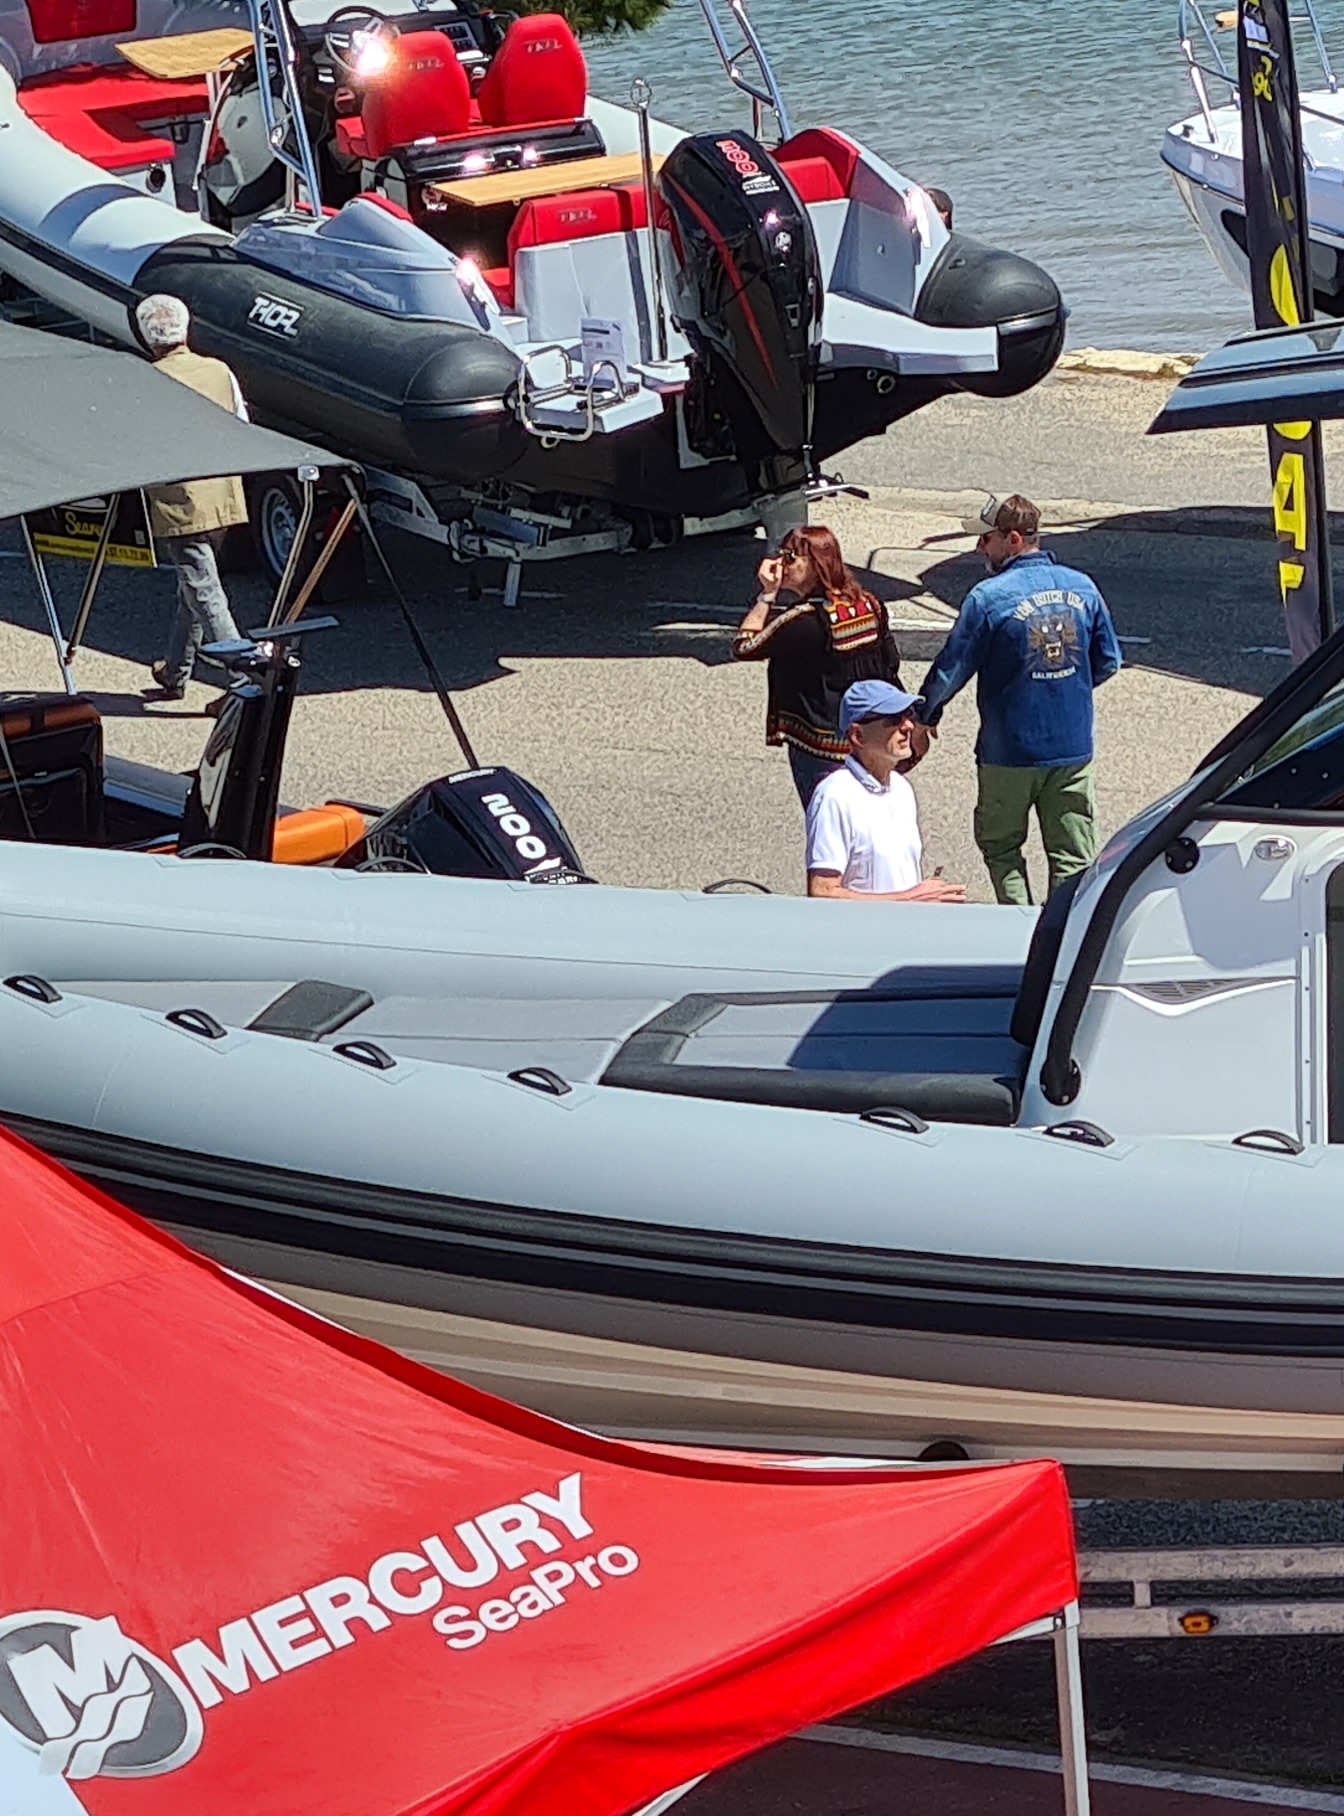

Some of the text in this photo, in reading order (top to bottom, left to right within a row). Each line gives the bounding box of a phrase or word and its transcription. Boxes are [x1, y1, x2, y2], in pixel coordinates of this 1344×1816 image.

[480, 793, 546, 860] 200
[171, 1471, 596, 1710] MERCURY
[432, 1544, 640, 1651] SeaPro
